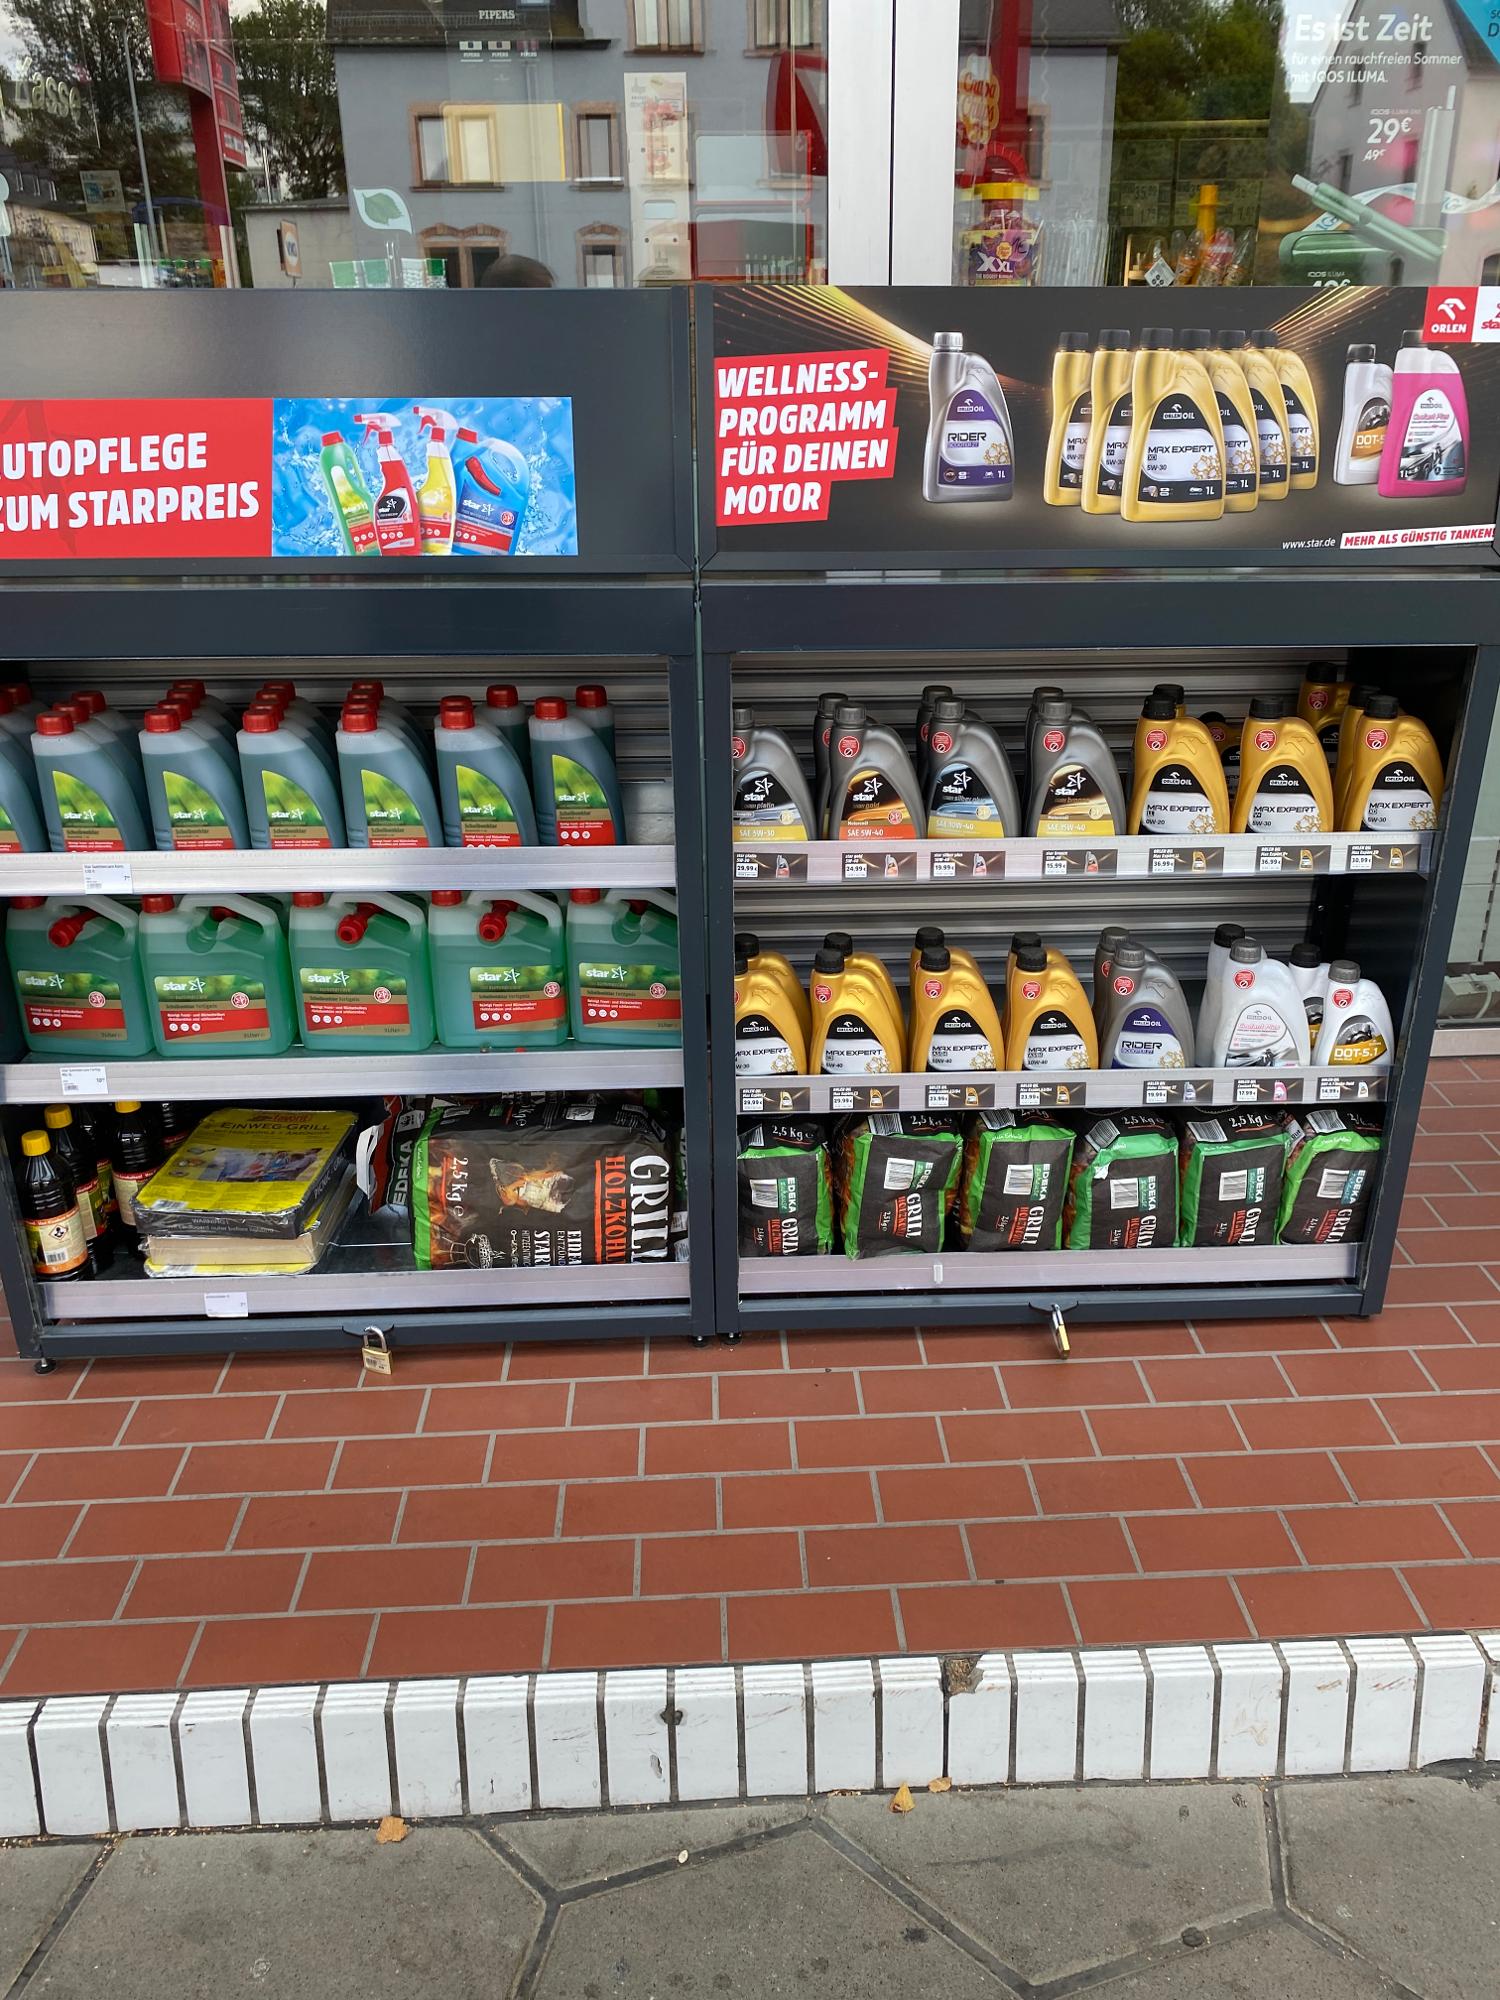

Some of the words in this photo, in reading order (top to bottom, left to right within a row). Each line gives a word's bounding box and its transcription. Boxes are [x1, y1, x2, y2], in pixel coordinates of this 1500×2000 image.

[479, 10, 515, 19] PIPERS
[1295, 14, 1325, 41] Es
[1334, 14, 1370, 41] ist
[1376, 14, 1433, 41] Zeit
[1311, 53, 1342, 65] einen
[1344, 52, 1411, 65] rauchfreien
[1414, 52, 1463, 65] Sommer
[976, 251, 1013, 273] XXL
[1431, 323, 1467, 334] ORLEN
[718, 361, 878, 398] WELLNESS-
[718, 399, 887, 438] PROGRAMM
[1182, 412, 1195, 420] OIL
[947, 433, 987, 442] RIDER
[1148, 446, 1171, 454] MAX
[1172, 444, 1214, 453] EXPERT
[0, 432, 207, 480] UTOPFLEGE
[721, 440, 776, 476] FÜR
[783, 439, 888, 471] DEINEN
[1302, 461, 1310, 469] 1L
[1272, 470, 1281, 478] 1L
[1241, 480, 1249, 488] 1L
[1205, 486, 1214, 495] 1L
[723, 482, 822, 516] MOTOR
[0, 494, 58, 532] UM
[68, 481, 259, 528] STARPREIS
[463, 500, 480, 511] star
[1282, 538, 1336, 550] www.star.de
[1344, 535, 1375, 547] MEHR
[1378, 534, 1398, 545] ALS
[1401, 530, 1446, 543] GÜNSTIG
[1450, 527, 1496, 541] TANKEN!
[942, 785, 964, 794] star
[1055, 787, 1077, 796] star
[744, 793, 765, 801] star
[853, 793, 874, 801] star
[271, 811, 290, 819] star
[369, 810, 389, 818] star
[463, 806, 481, 814] star
[64, 812, 82, 820] star
[861, 829, 884, 837] 5W-40
[307, 974, 332, 984] star
[478, 972, 501, 983] star
[586, 968, 609, 979] star
[25, 977, 47, 987] star
[163, 981, 187, 991] star
[1121, 1041, 1163, 1049] RIDER
[752, 1047, 788, 1055] EXPERT
[1334, 1047, 1378, 1057] DOT-5.1
[220, 1121, 331, 1131] EINWEG-GRILL
[1229, 1115, 1247, 1127] 2,5
[1247, 1114, 1263, 1126] kg
[392, 1140, 413, 1206] EDEKA
[449, 1157, 469, 1179] 2,5
[915, 1162, 933, 1190] EDEKA
[1038, 1163, 1050, 1201] EDEKA
[1254, 1167, 1265, 1203] EDEKA
[1349, 1170, 1366, 1204] EDEKA
[445, 1183, 468, 1202] kg
[787, 1177, 798, 1213] EDEKA
[1147, 1175, 1156, 1211] EDEKA
[906, 1192, 922, 1238] GRILL
[1021, 1206, 1044, 1244] GRILL
